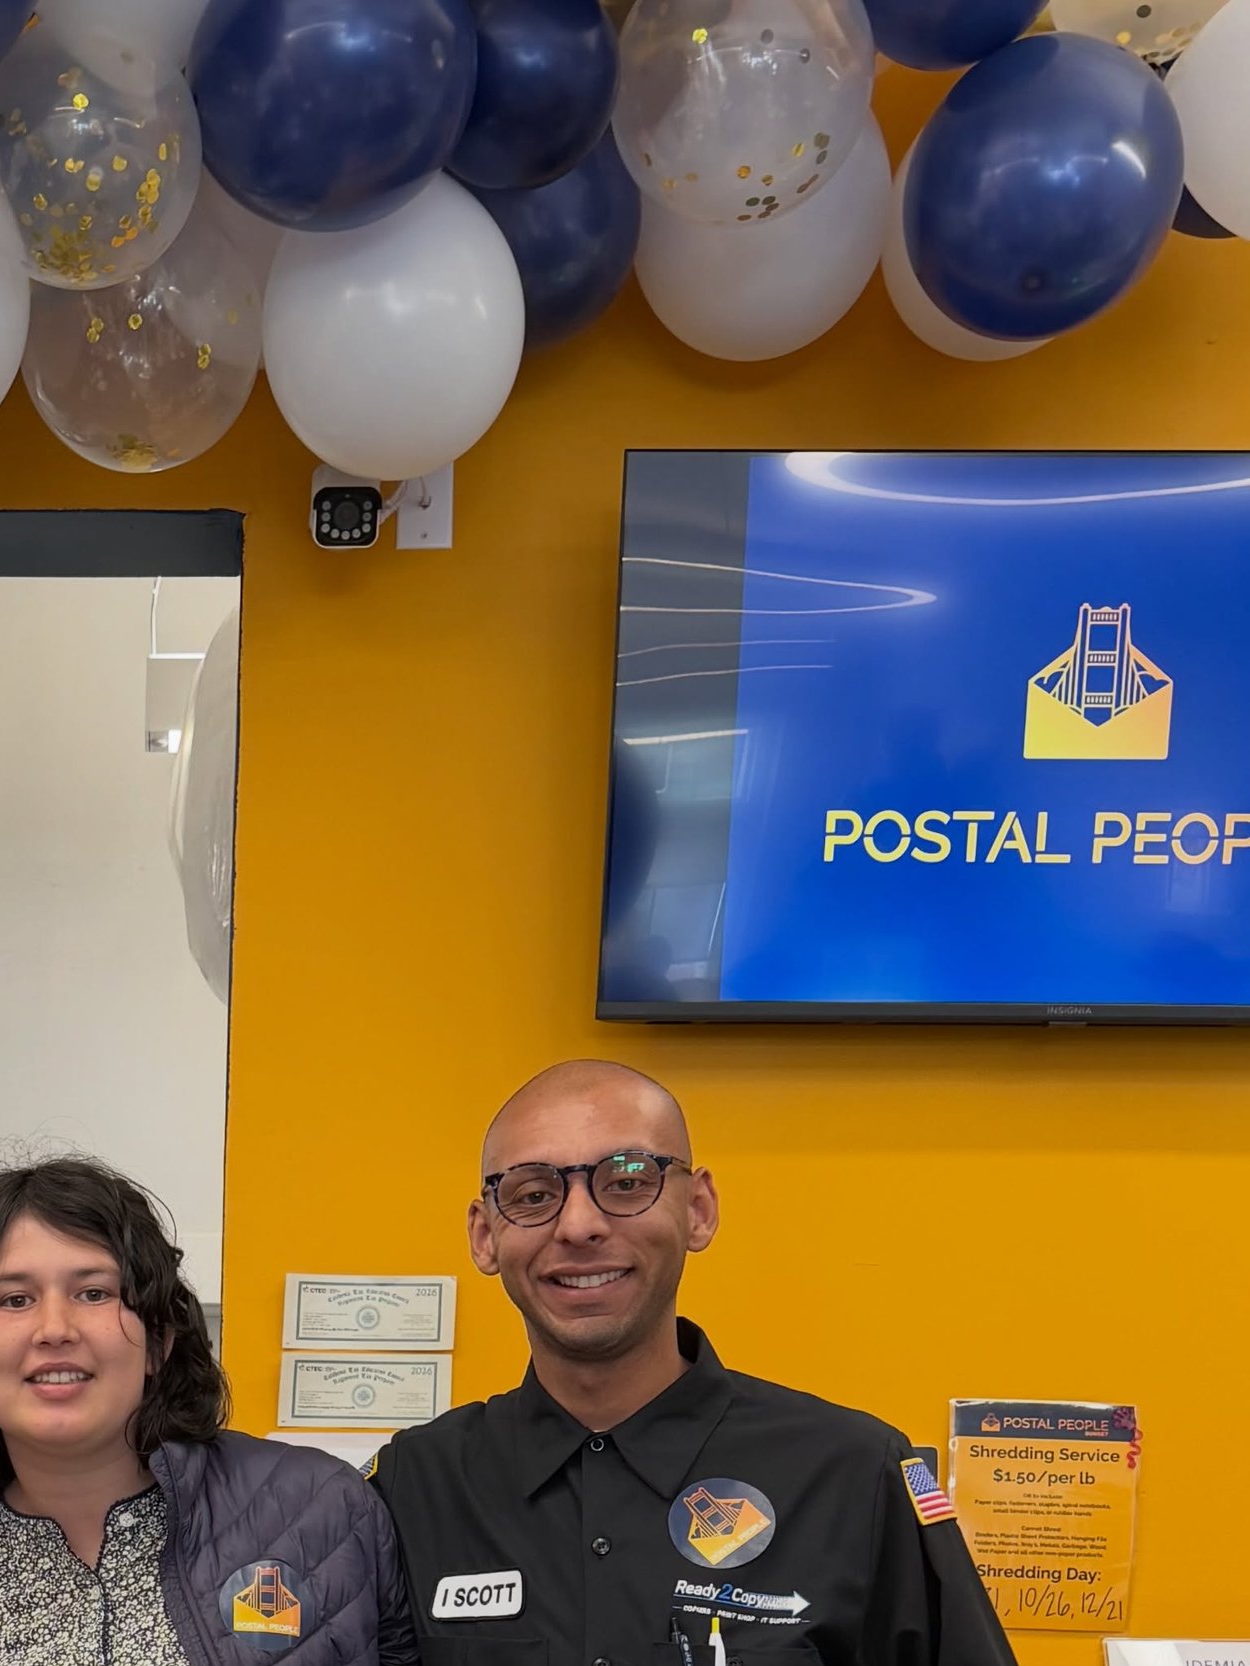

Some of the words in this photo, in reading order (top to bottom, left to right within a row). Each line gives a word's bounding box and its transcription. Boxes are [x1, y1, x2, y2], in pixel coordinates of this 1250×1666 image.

[823, 810, 1071, 863] POSTAL
[1003, 1417, 1055, 1430] POSTAL
[1058, 1418, 1109, 1432] PEOPLE
[970, 1445, 1054, 1463] Shredding
[1059, 1448, 1120, 1463] Service
[993, 1468, 1075, 1487] $1.50/per
[1079, 1471, 1096, 1485] lb
[977, 1564, 1062, 1584] Shredding
[1066, 1567, 1102, 1585] Day:
[442, 1589, 449, 1607] I
[453, 1582, 516, 1607] SCOTT
[1081, 1587, 1123, 1621] 12/21
